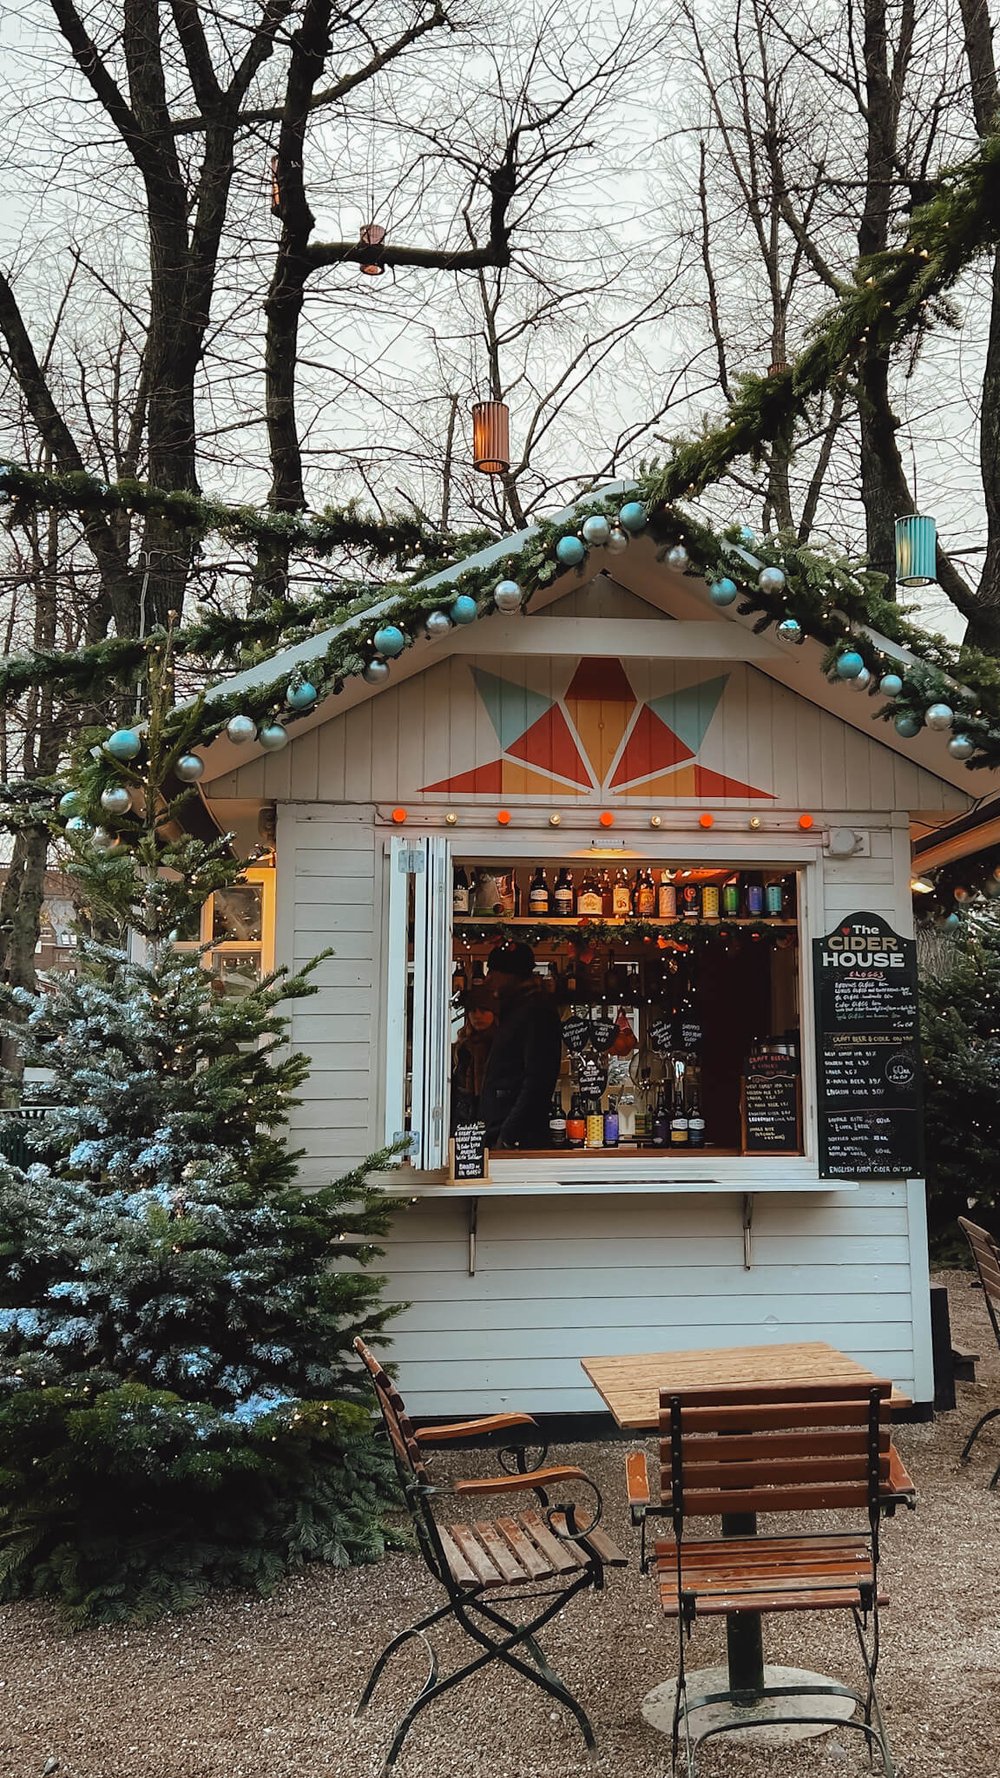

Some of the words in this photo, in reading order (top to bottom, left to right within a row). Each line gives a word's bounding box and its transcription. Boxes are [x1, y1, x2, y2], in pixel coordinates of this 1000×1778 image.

[853, 925, 879, 934] The
[828, 936, 898, 950] CIDER
[822, 952, 904, 967] HOUSE
